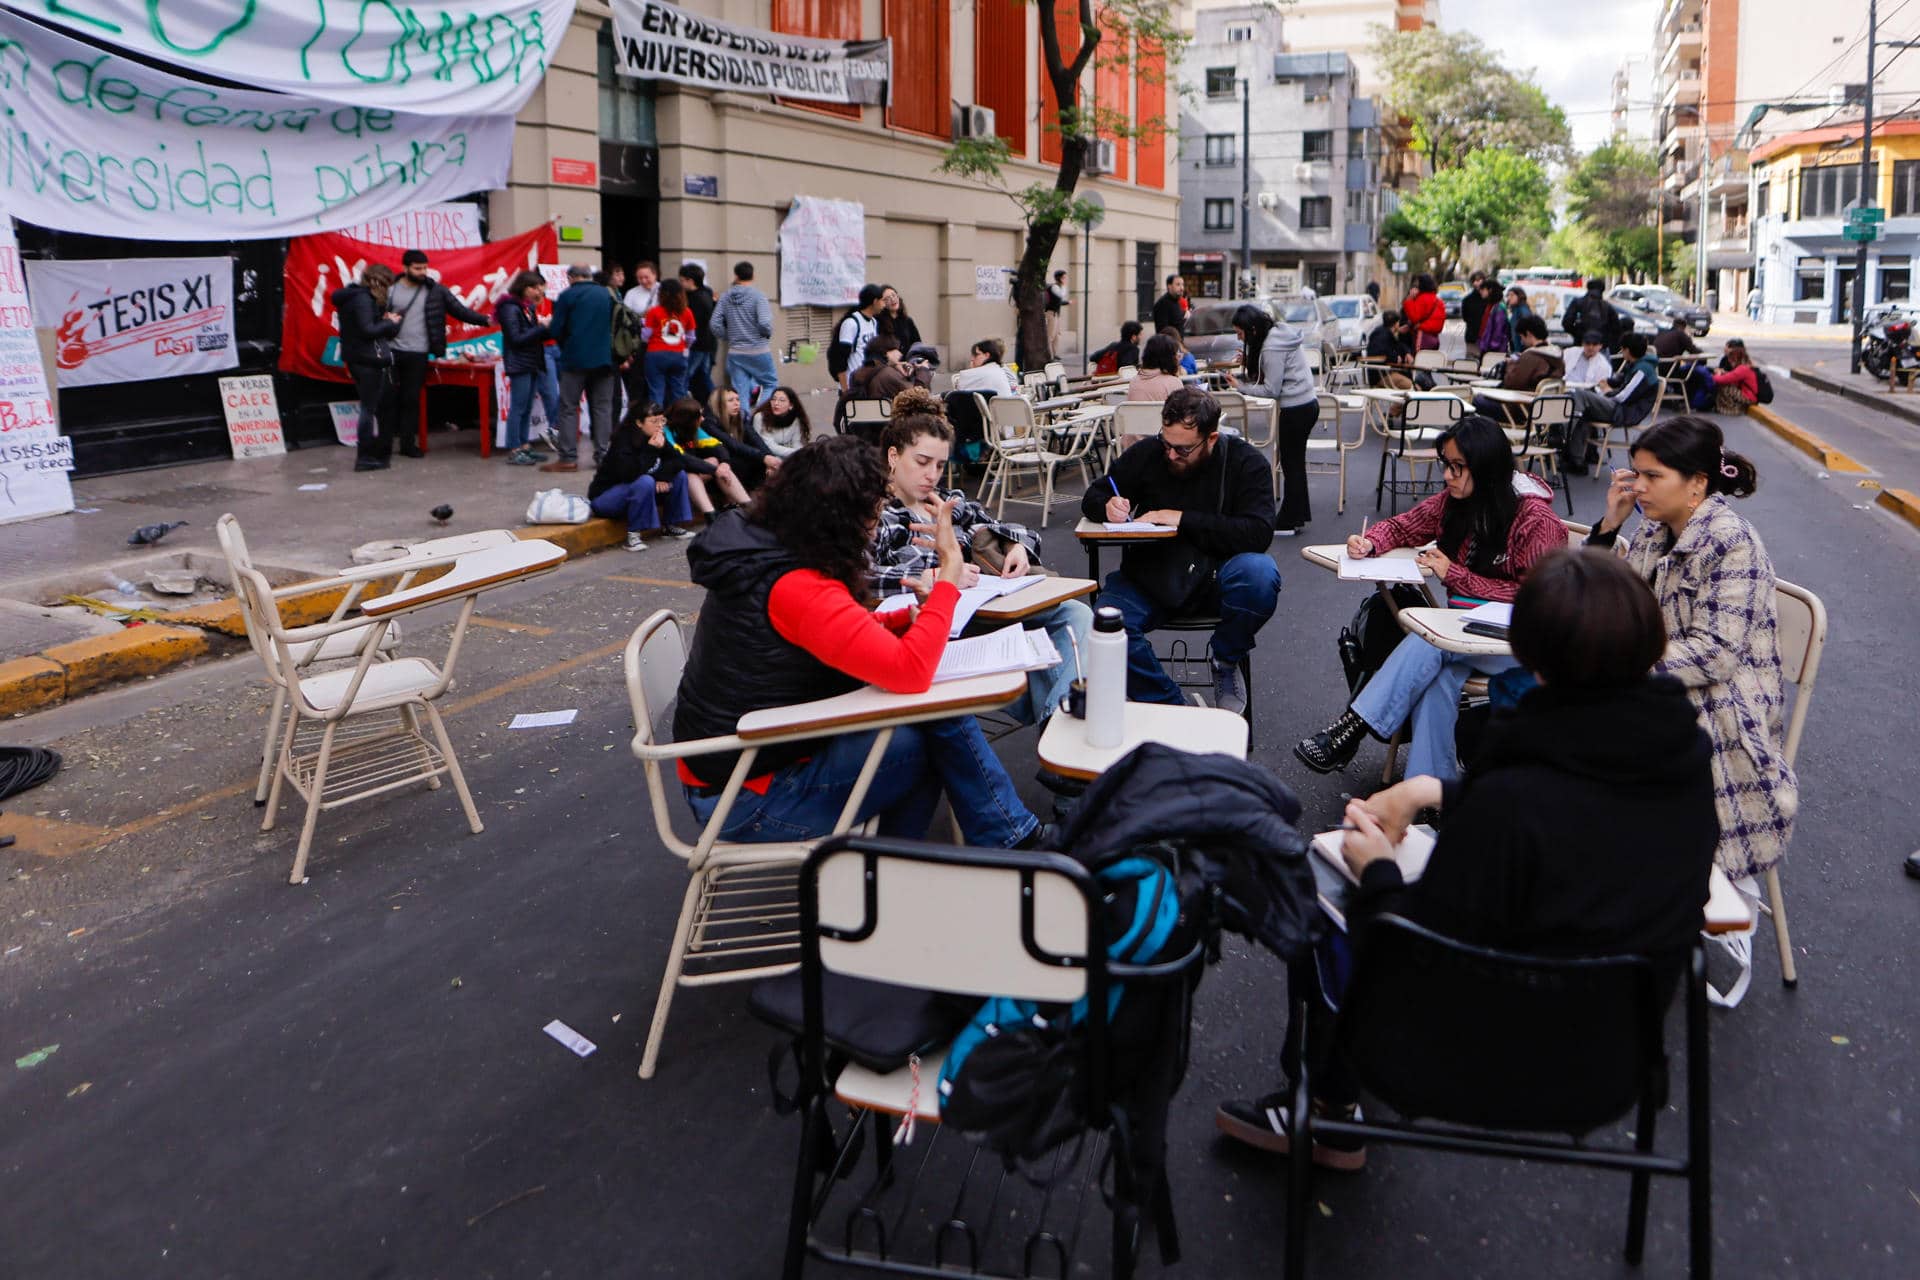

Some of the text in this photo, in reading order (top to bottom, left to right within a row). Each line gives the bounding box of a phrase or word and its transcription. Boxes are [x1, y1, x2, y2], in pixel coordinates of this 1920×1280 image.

[642, 3, 678, 36] EN
[684, 17, 780, 57] DEFENSA
[769, 61, 842, 96] PUBLICA
[331, 105, 395, 138] de
[87, 274, 212, 338] TESIS XI
[226, 392, 272, 409] CAER
